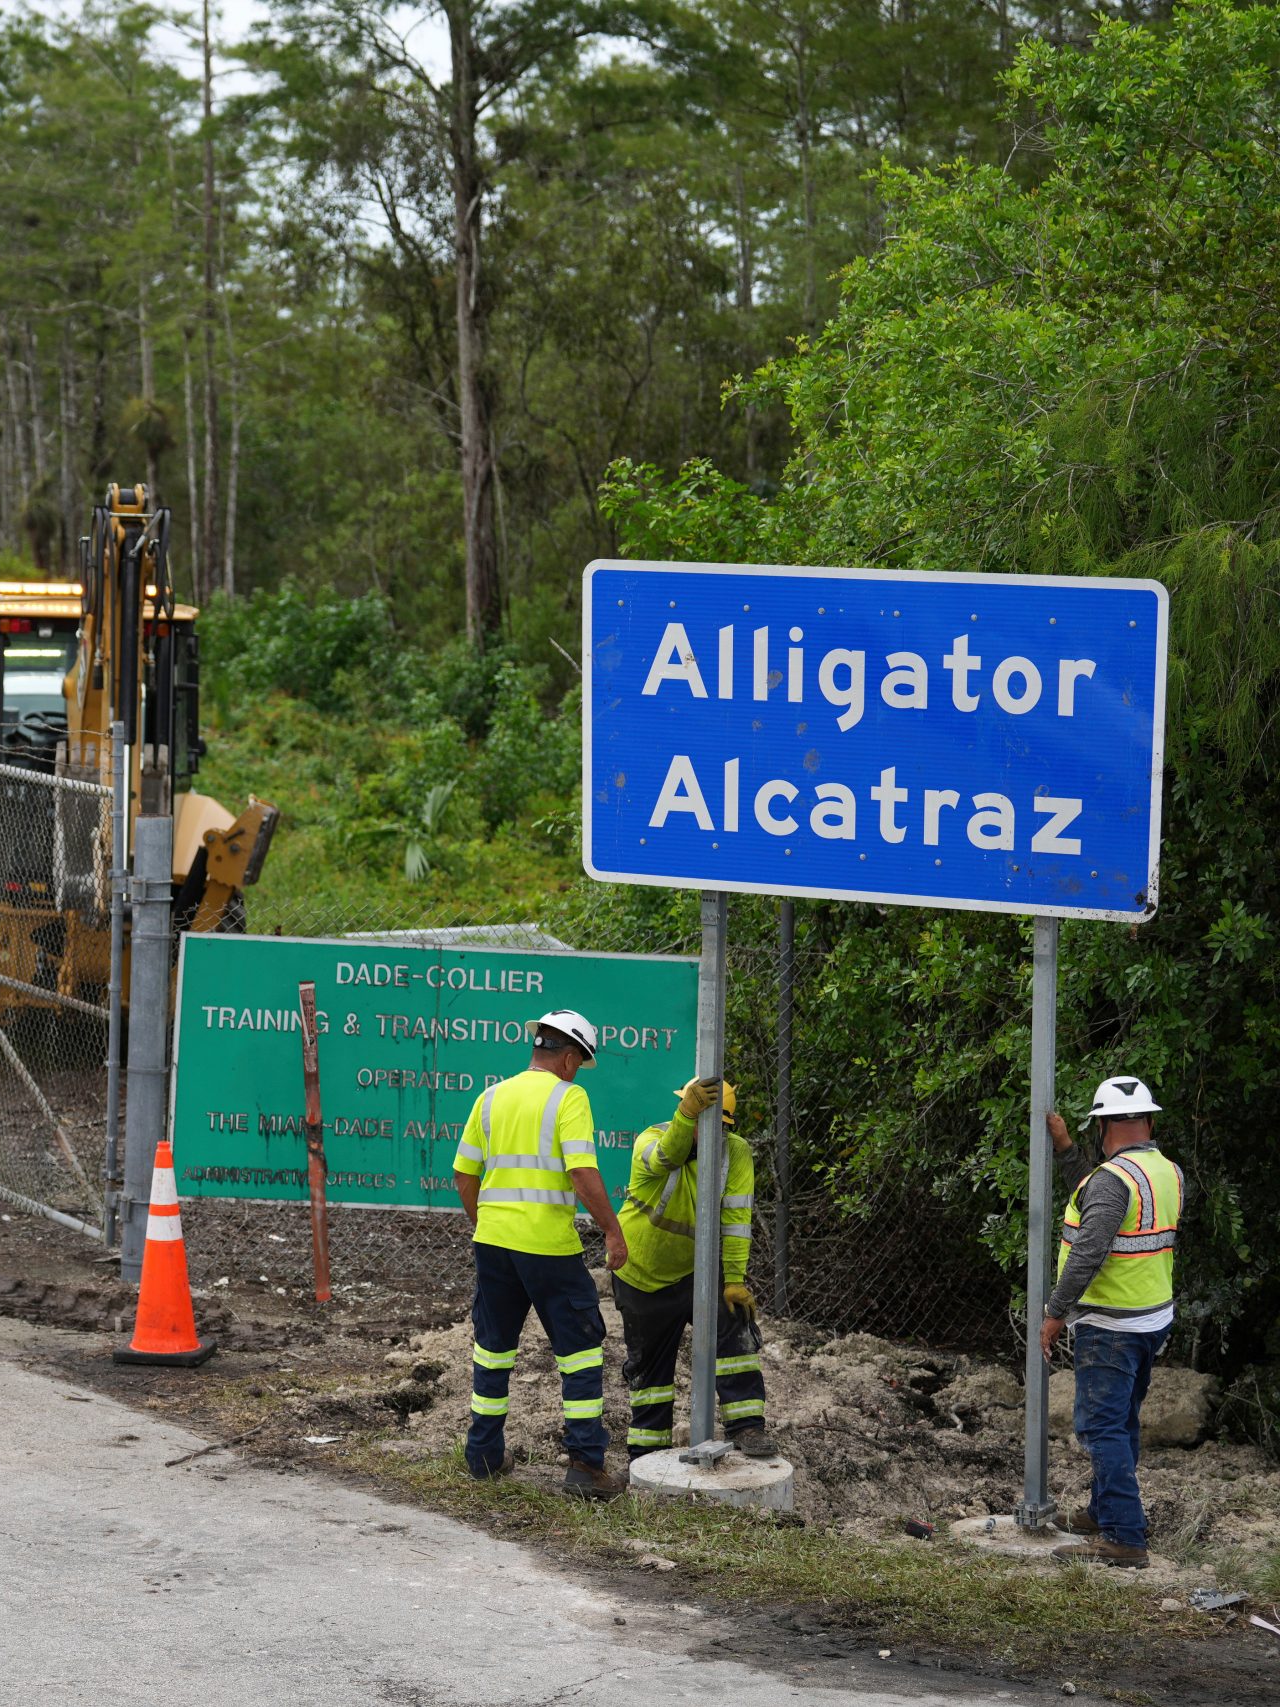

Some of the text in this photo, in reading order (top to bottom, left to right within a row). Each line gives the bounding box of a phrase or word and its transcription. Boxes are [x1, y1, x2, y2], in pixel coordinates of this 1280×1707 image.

[641, 622, 1097, 732] Alligator
[648, 755, 1083, 855] Alcatraz
[336, 962, 544, 993] DADE-COLLIER
[201, 1006, 329, 1034] TRAINING
[343, 1013, 360, 1035] &
[593, 1025, 677, 1049] PORT
[357, 1068, 474, 1091] OPERATED
[206, 1111, 464, 1141] THE MIA-DADE AVIAT
[183, 1166, 309, 1186] ADMINISTRATIV
[326, 1170, 396, 1188] OFFICES
